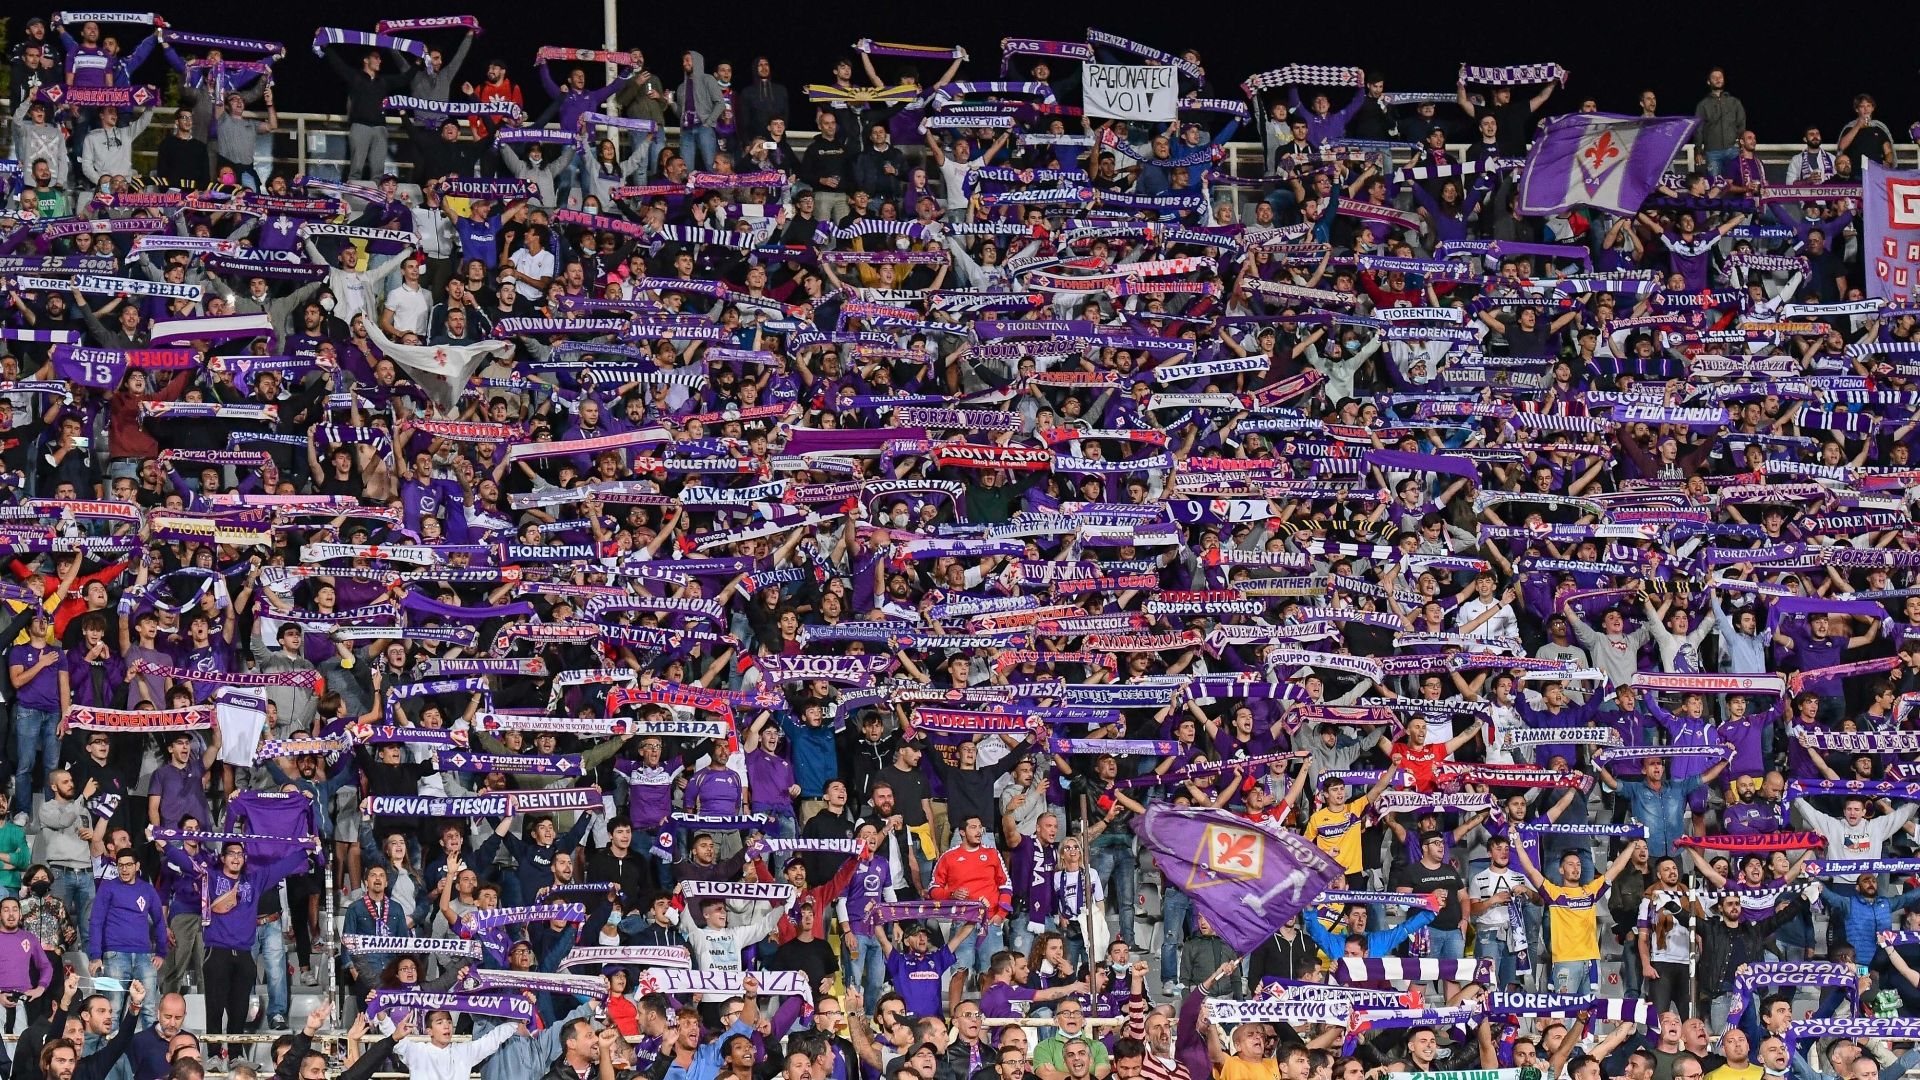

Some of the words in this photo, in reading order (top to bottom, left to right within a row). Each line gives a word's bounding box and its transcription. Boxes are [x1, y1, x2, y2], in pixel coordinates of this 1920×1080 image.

[72, 13, 142, 23] FIORENTINA
[419, 17, 462, 26] COSTA
[183, 34, 263, 50] FIORENTINA
[1008, 41, 1039, 51] RAS
[1089, 28, 1127, 47] FIRENZE
[1129, 40, 1161, 61] VANTO
[1171, 55, 1200, 79] GLORIA
[1089, 65, 1172, 90] RAGIONATECI
[66, 89, 129, 104] FIORENTINA
[1105, 91, 1153, 114] VOI!
[388, 95, 512, 115] UNONOVEDUESEI
[1203, 98, 1243, 112] MERDA
[523, 130, 542, 138] vento
[549, 130, 572, 139] labaro
[451, 182, 527, 196] FIORENTINA
[998, 187, 1078, 203] FIORENTINA
[1771, 188, 1802, 197] VIOLA
[1809, 188, 1858, 197] FOREVER
[117, 192, 183, 205] FIORENTINA
[559, 210, 597, 227] JUVE
[612, 219, 646, 236] ODIO
[953, 223, 1034, 234] FIORENTINA
[308, 223, 412, 243] FIORENTINA
[1175, 230, 1236, 249] FIORENTINA
[145, 239, 212, 248] FIORENTINA
[78, 258, 114, 270] 2003
[293, 266, 312, 275] VIOLA
[73, 275, 123, 292] SETTE
[148, 283, 199, 298] BELLO
[1053, 278, 1123, 290] FIORENTINA
[943, 294, 1030, 306] FIORENTINA
[1384, 308, 1453, 320] FIORENTINA
[1792, 302, 1877, 315] FIORENTINA
[629, 326, 663, 338] JUVE
[675, 326, 719, 339] MERDA
[1007, 322, 1069, 333] FIORENTINA
[1387, 328, 1408, 338] ACF
[1409, 327, 1474, 341] FIORENTINA
[970, 342, 1018, 360] VIOLA
[1027, 340, 1079, 358] FORZA
[1136, 339, 1195, 353] FIESOLE
[70, 347, 120, 363] ASTORI
[253, 358, 312, 373] Fiorentina
[1160, 366, 1202, 382] JUVE
[1206, 355, 1269, 374] MERDA
[1702, 356, 1740, 370] FORZA
[1741, 356, 1788, 371] RAGAZZI
[80, 362, 113, 384] 13
[1040, 371, 1104, 383] FIORENTINA
[1443, 370, 1486, 383] VECCHIA
[910, 410, 958, 426] FORZA
[963, 410, 1012, 426] VIOLA
[1625, 405, 1668, 420] VIOLA
[1669, 407, 1723, 422] AVANTI
[424, 422, 510, 438] FIORENTINA
[744, 419, 764, 430] FILA
[1235, 420, 1256, 431] ACF
[1257, 418, 1324, 432] FIORENTINA
[173, 450, 207, 460] Forza
[208, 450, 260, 460] Fiorentina
[1057, 456, 1102, 470] FORZA
[1117, 454, 1167, 470] CUORE
[663, 458, 737, 470] COLLETTIVO
[684, 487, 728, 501] JUVE
[794, 485, 827, 499] Forza
[866, 479, 964, 499] FIORENTINA
[54, 501, 131, 516] FIORENTINA
[1187, 501, 1203, 520] 9
[1240, 500, 1253, 519] 2
[1816, 511, 1907, 530] FIORENTINA
[168, 521, 260, 539] FIORENTINA
[1555, 525, 1589, 535] Fiorentina
[52, 537, 114, 547] FIORENTINA
[694, 532, 727, 543] firenze
[321, 546, 357, 558] FORZA
[391, 549, 423, 561] VIOLA
[508, 545, 596, 559] FIORENTINA
[1220, 549, 1306, 566] FIORENTINA
[1713, 547, 1777, 560] FIORENTINA
[1831, 551, 1886, 567] FORZA
[1535, 559, 1556, 569] ACF
[1558, 560, 1624, 574] FIORENTINA
[399, 569, 498, 582] COLLETTIVO
[1059, 580, 1097, 592] JUVE
[1115, 575, 1158, 588] ODIO
[1235, 583, 1262, 593] FROM
[1270, 579, 1312, 591] FATHER
[946, 602, 979, 616] ONDA
[1147, 601, 1202, 614] GRUPPO
[1205, 600, 1263, 614] STORICO
[1304, 606, 1352, 618] MERDA
[1059, 618, 1130, 630] FIORENTINA
[1225, 625, 1264, 638] FORZA
[1268, 623, 1322, 638] RAGAZZI
[915, 638, 1008, 650] FIORENTINA
[1557, 652, 1574, 661] NIKE
[440, 659, 478, 672] FORZA
[482, 660, 519, 672] VIOLA
[784, 657, 867, 672] VIOLA
[1270, 652, 1312, 665] GRUPPO
[1329, 656, 1378, 678] ANTIJUVE
[1384, 658, 1419, 671] Forza
[173, 667, 280, 686] FIORENTINA
[1658, 676, 1740, 689] FIORENTINA
[230, 697, 257, 707] Mediacom
[1361, 697, 1391, 707] ACF
[1395, 698, 1491, 714] FIORENTINA
[94, 712, 187, 727] FIORENTINA
[1299, 707, 1324, 719] ALE
[513, 721, 530, 729] PRIMO
[532, 722, 551, 730] AMORE
[645, 721, 721, 735] MERDA
[923, 711, 1026, 731] FIORENTINA
[396, 728, 447, 739] Fiorentina
[1515, 729, 1554, 744] FAMMI
[1560, 729, 1606, 741] GODERE
[470, 755, 553, 767] A.C.FIORENTINA
[373, 796, 427, 815] CURVA
[452, 797, 508, 814] FIESOLE
[1388, 792, 1427, 807] FORZA
[1432, 791, 1485, 807] RAGAZZI
[1526, 823, 1546, 832] ACF
[1550, 823, 1622, 835] FIORENTINA
[766, 841, 862, 857] FIORENTINA
[1825, 861, 1856, 872] Liberi
[559, 883, 609, 892] FIORENTINA
[532, 910, 558, 921] APRILE
[362, 937, 418, 951] FAMMI
[421, 939, 467, 951] GODERE
[668, 968, 807, 995] FIRENZE
[1287, 985, 1401, 1008] FIORENTINA
[1493, 990, 1597, 1009] FIORENTINA
[467, 994, 505, 1011] CON
[509, 998, 534, 1014] VOI
[1239, 1001, 1326, 1017] COLLETTIVO
[1412, 1017, 1437, 1026] FIRENZE
